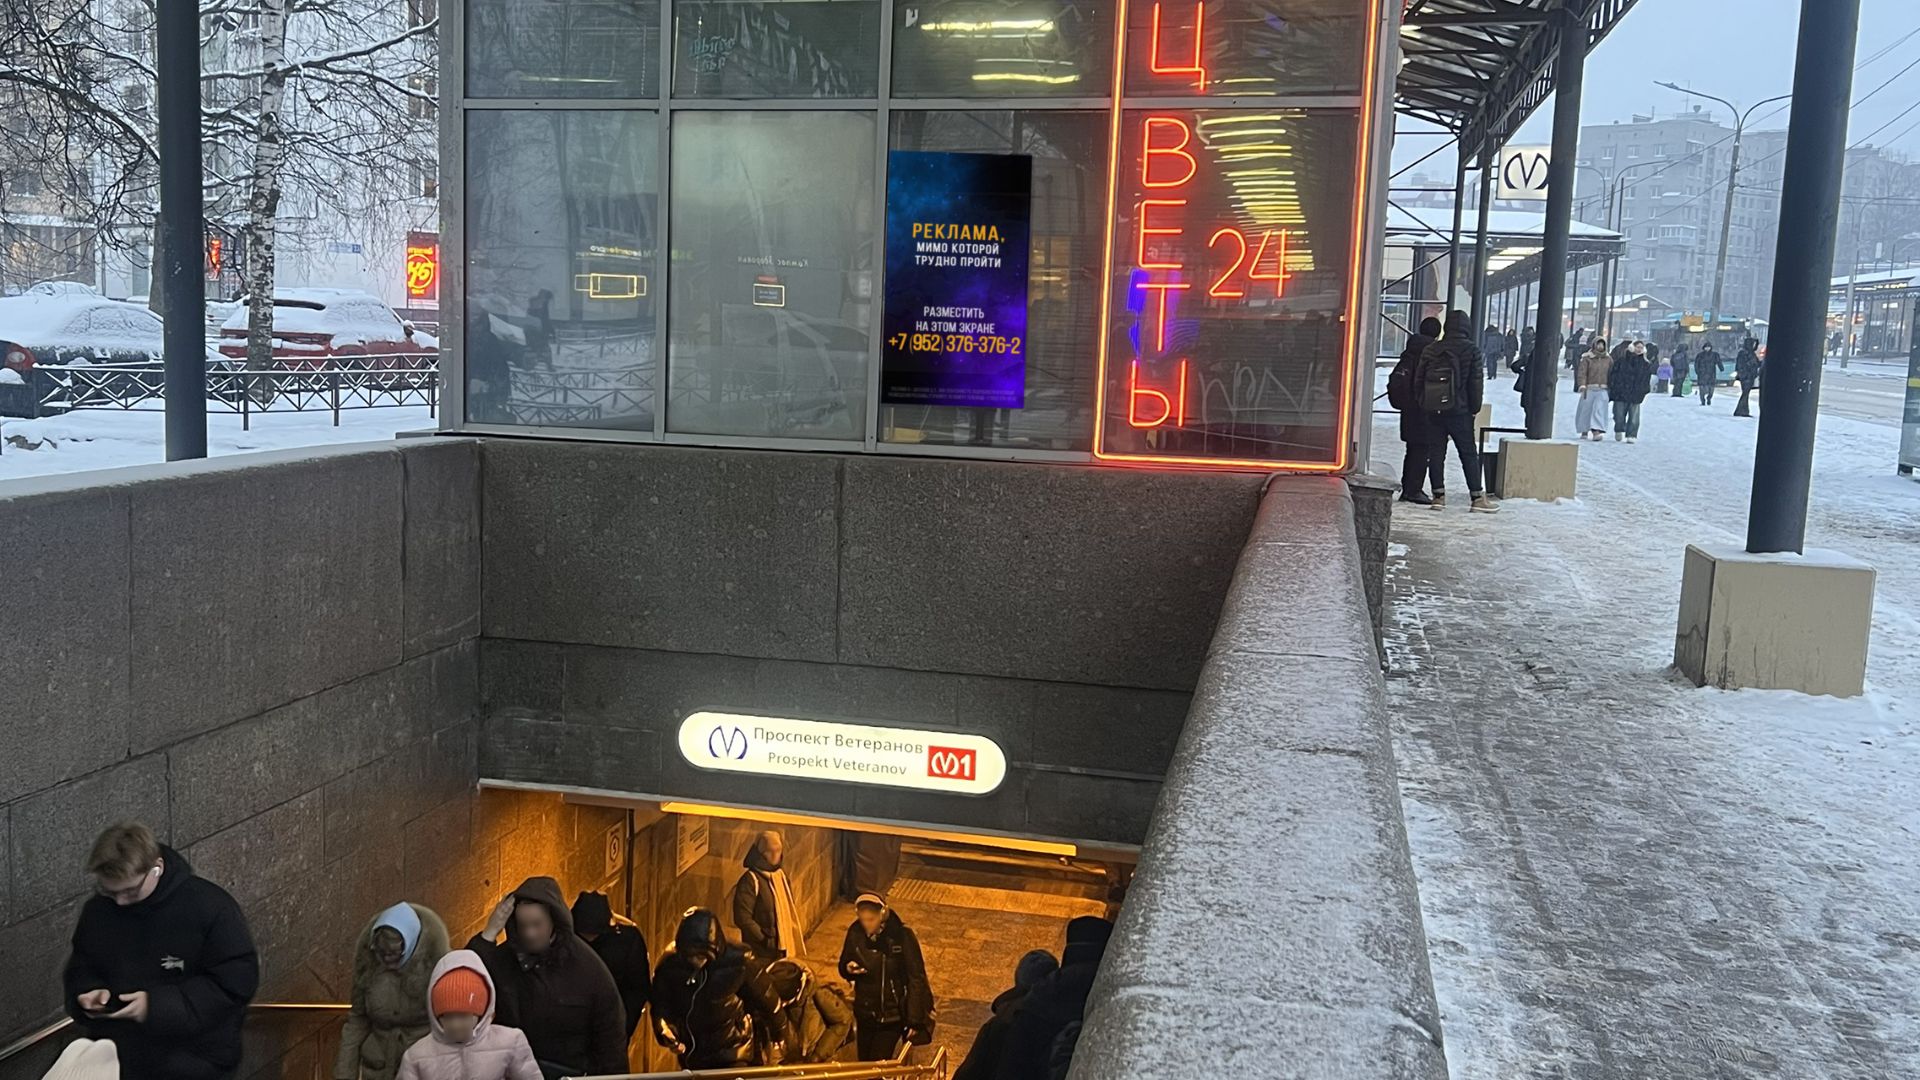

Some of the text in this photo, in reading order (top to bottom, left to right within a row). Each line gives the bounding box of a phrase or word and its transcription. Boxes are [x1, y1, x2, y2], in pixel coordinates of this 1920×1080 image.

[1127, 1, 1208, 429] ЦВЕТЫ
[912, 222, 1005, 243] РЕКЛАМА,
[916, 241, 999, 255] МИМО КОТОРОЙ
[915, 254, 1001, 268] ТРУДНО ПРОЙТИ
[1208, 227, 1292, 298] 24
[923, 306, 985, 319] РАЗМЕСТИТЬ
[915, 321, 996, 334] НА ЭТОМ ЭКРАНЕ
[888, 332, 1021, 355] +7 (952) 376-376-2
[753, 727, 830, 747] Проспект
[834, 733, 924, 756] Ветеранов
[767, 751, 908, 776] Prospekt Veteranov
